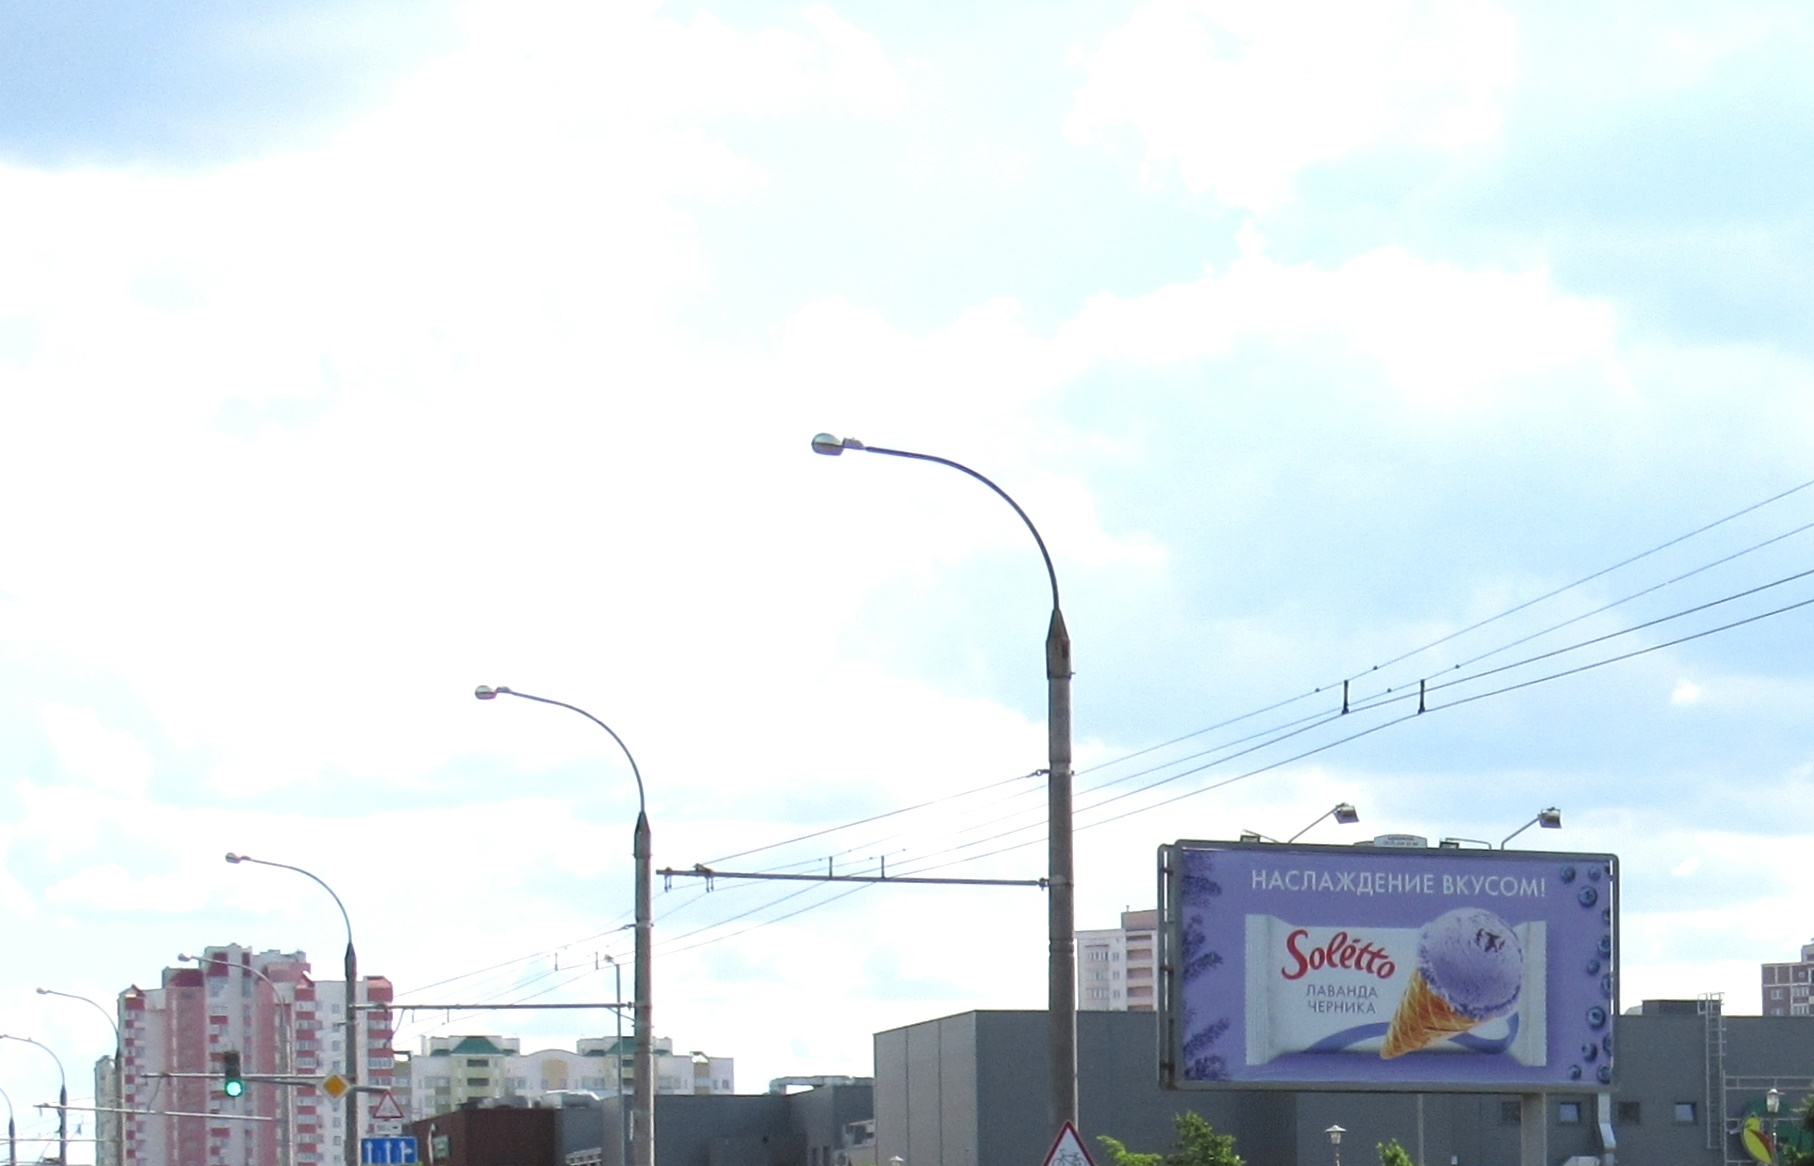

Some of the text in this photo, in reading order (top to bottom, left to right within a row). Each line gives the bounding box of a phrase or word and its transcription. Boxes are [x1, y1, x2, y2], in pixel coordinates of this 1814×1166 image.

[1252, 869, 1546, 898] НАСЛАЖДЕНИЕ ВКУСОМ!
[1306, 983, 1378, 1000] ЛАВАНДА
[1308, 1000, 1377, 1016] ЧЕРНИКА
